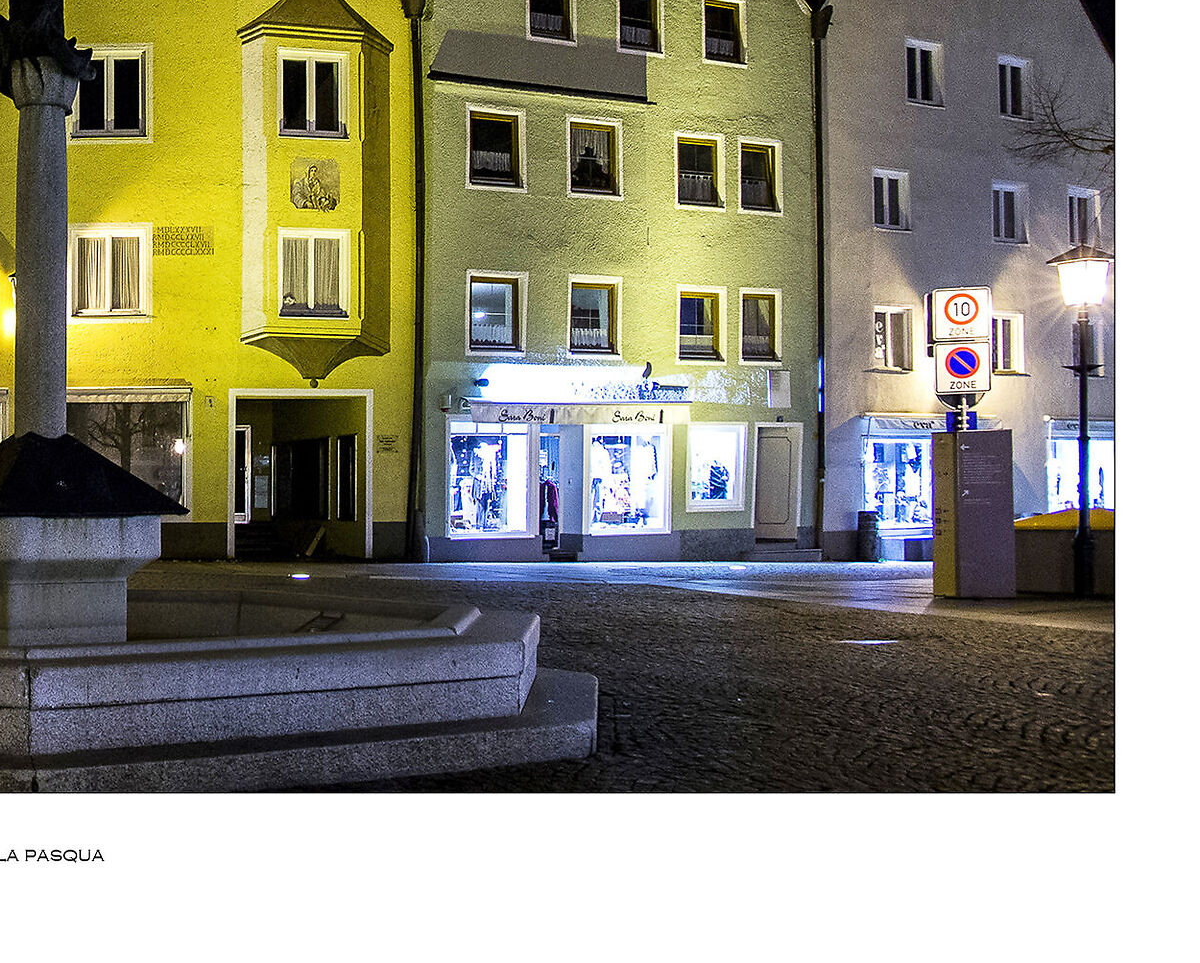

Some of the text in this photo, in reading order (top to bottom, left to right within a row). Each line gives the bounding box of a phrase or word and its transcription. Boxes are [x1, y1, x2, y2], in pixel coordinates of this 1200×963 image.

[953, 301, 970, 317] 10
[948, 326, 976, 336] ZONE
[949, 380, 977, 390] ZONE
